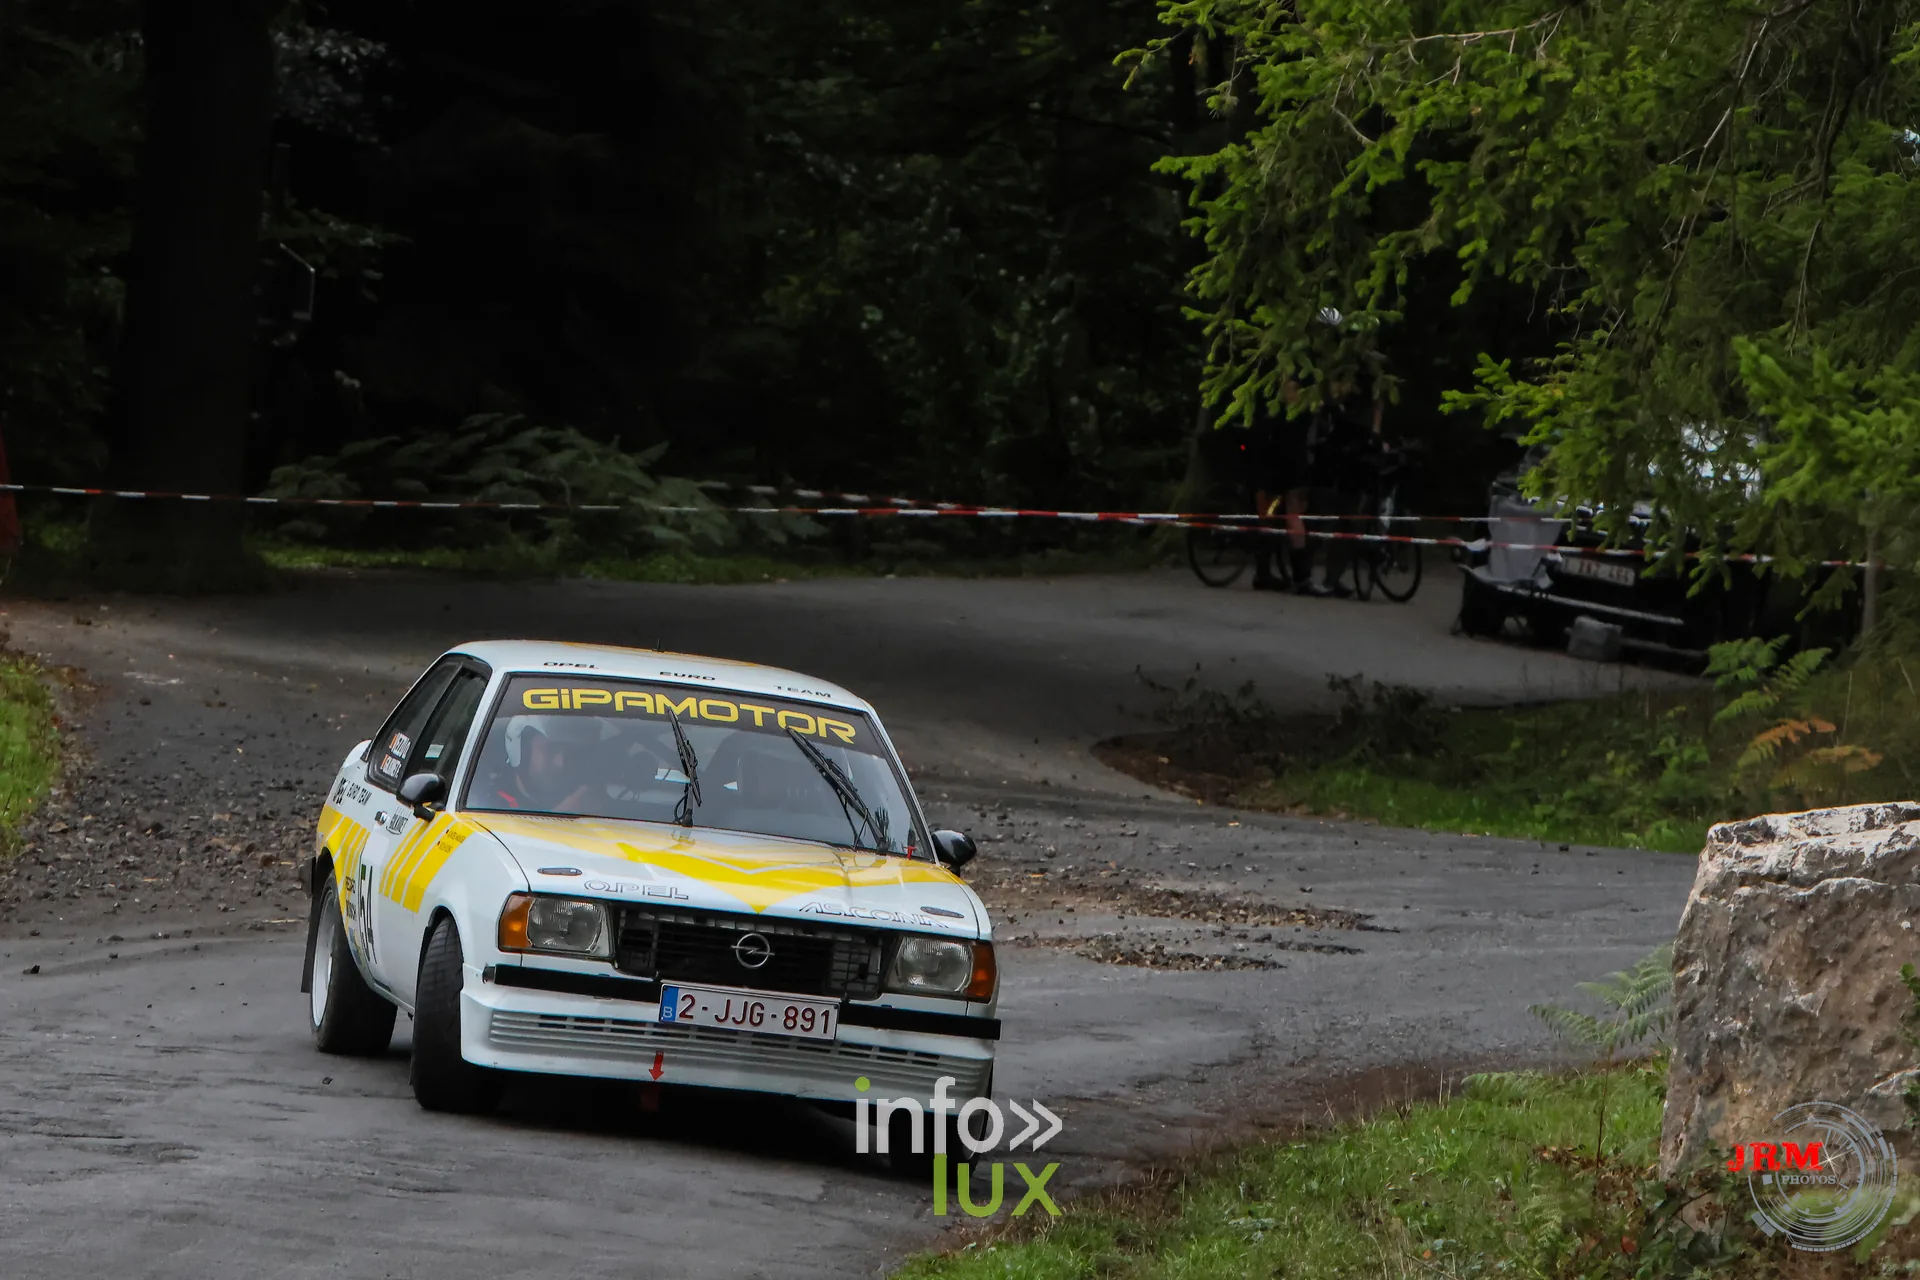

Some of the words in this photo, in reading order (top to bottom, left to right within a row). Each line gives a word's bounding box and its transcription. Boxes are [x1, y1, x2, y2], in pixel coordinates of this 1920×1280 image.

[543, 661, 599, 669] OPEL
[659, 671, 716, 681] EURO
[772, 684, 832, 699] TEAM
[584, 879, 689, 900] OPEL
[799, 901, 949, 929] ASCONA
[662, 1005, 673, 1019] B
[679, 993, 830, 1034] 2-JJG-891
